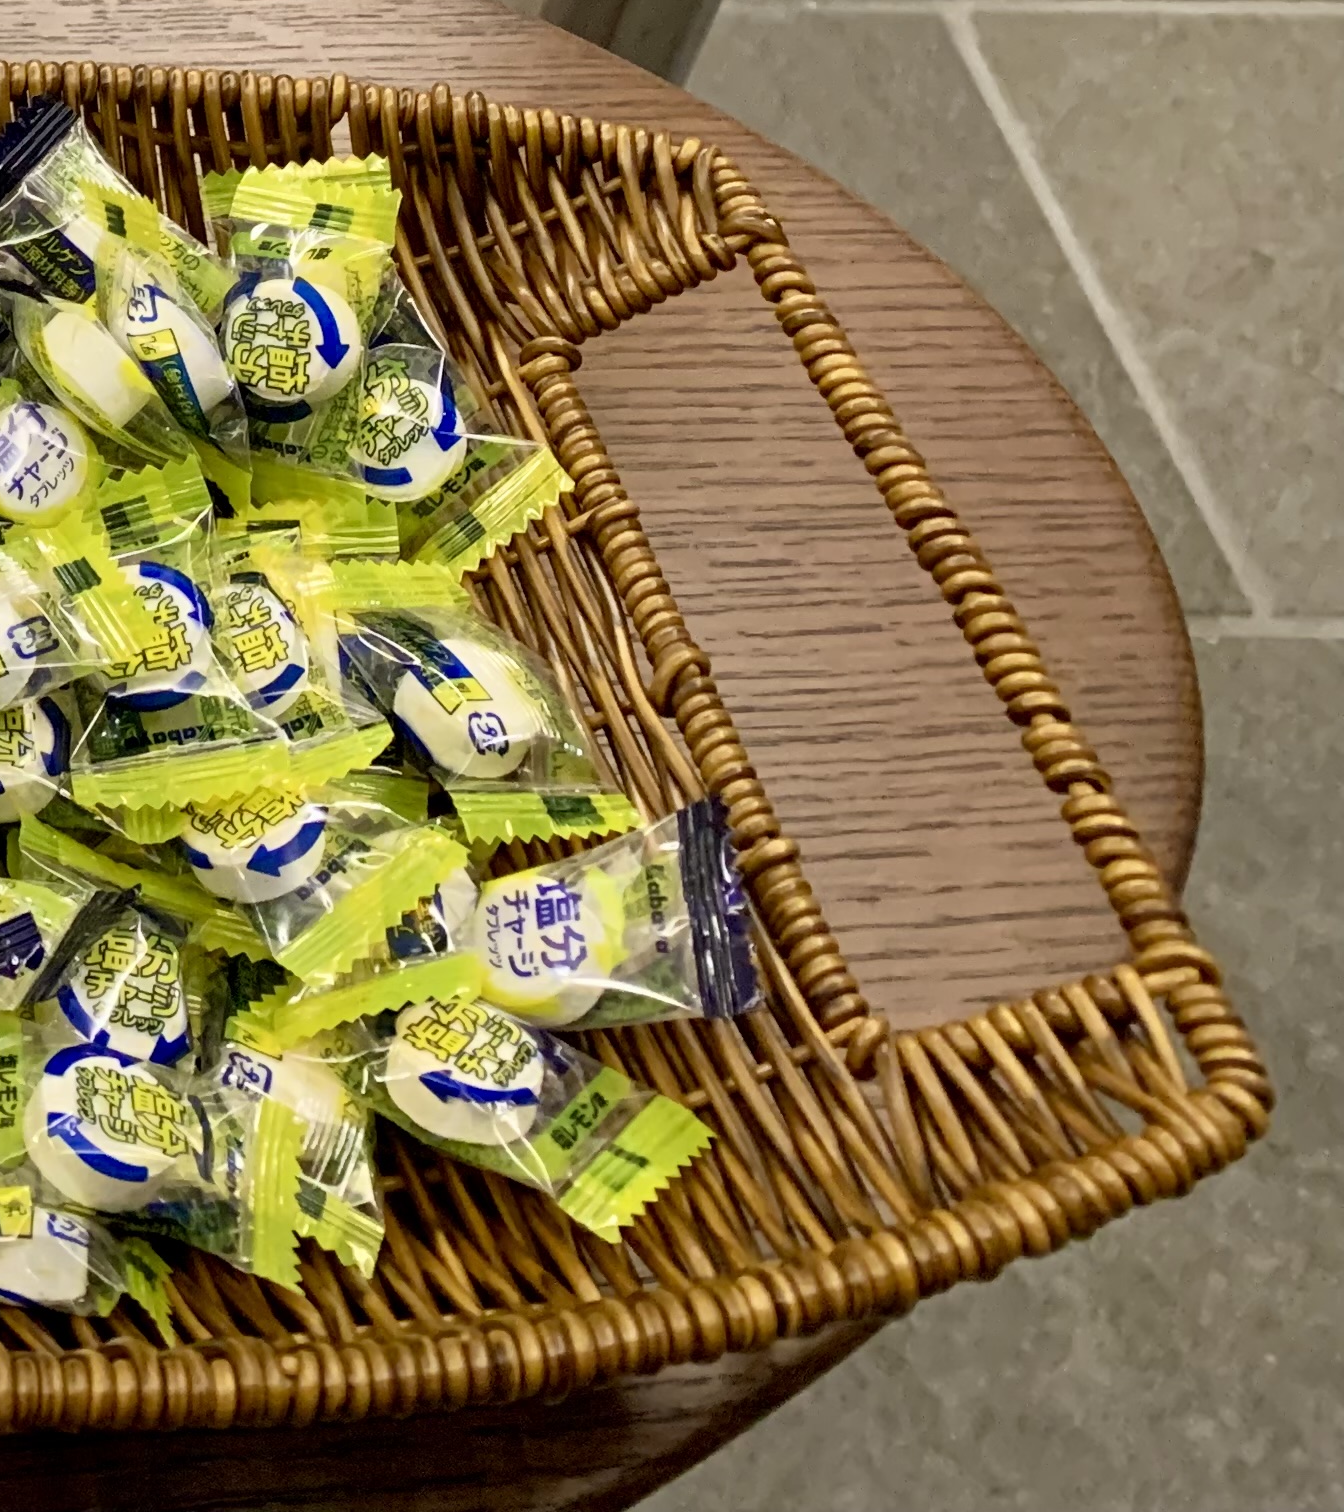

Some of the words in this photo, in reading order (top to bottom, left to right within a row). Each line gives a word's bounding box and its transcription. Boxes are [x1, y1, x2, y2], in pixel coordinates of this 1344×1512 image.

[230, 341, 312, 395] 塩分
[502, 890, 541, 978] チャージ
[535, 877, 589, 972] 塩分
[402, 997, 489, 1063] 塩分
[131, 1074, 191, 1158] 塩分
